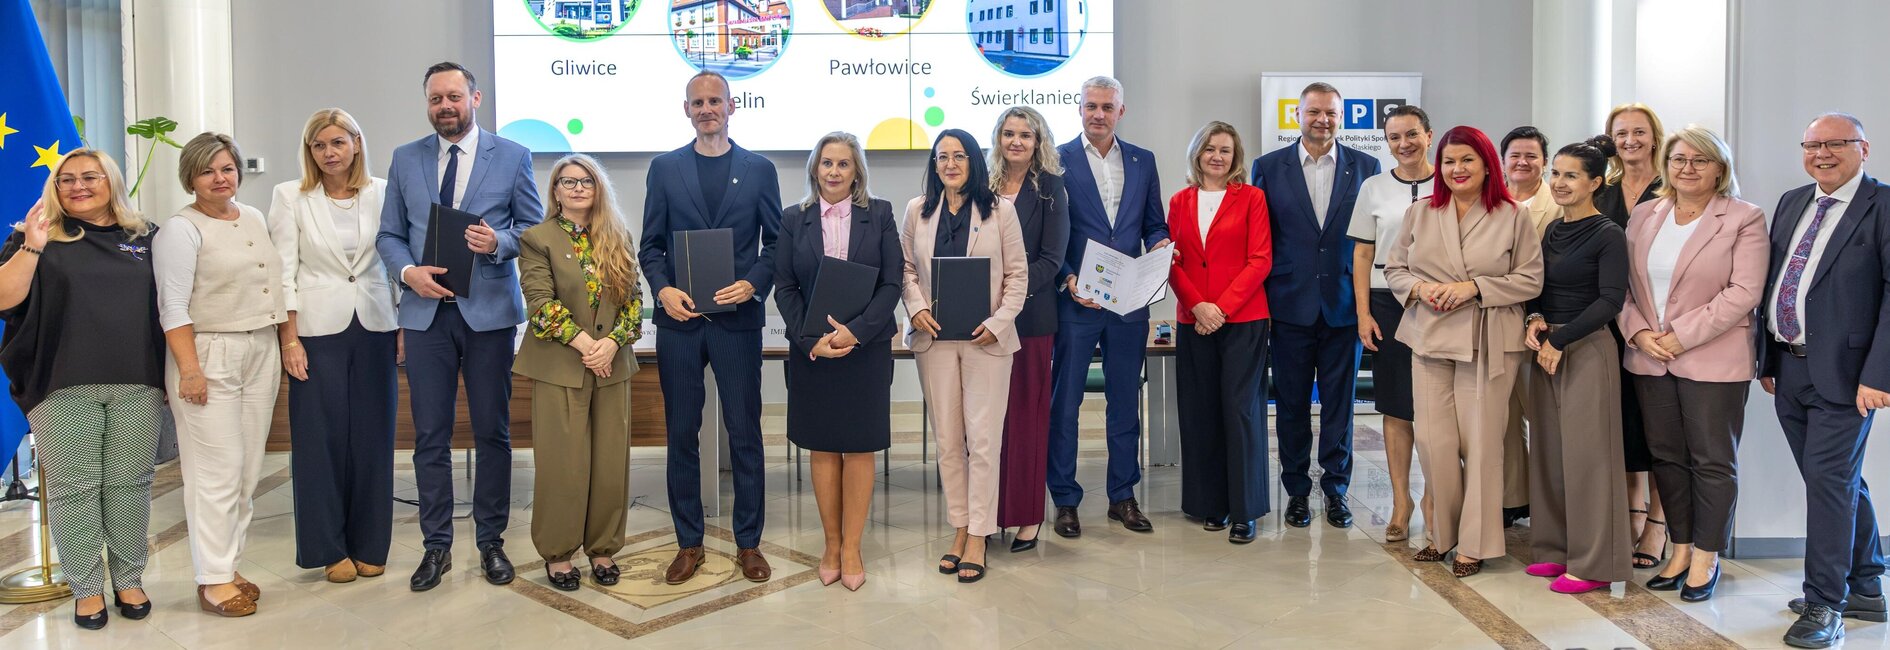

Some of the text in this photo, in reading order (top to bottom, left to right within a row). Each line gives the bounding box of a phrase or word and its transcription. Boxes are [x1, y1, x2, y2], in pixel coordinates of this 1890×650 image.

[551, 59, 617, 76] Gliwice
[830, 59, 932, 77] Pawłowice
[1345, 134, 1371, 143] Polityki
